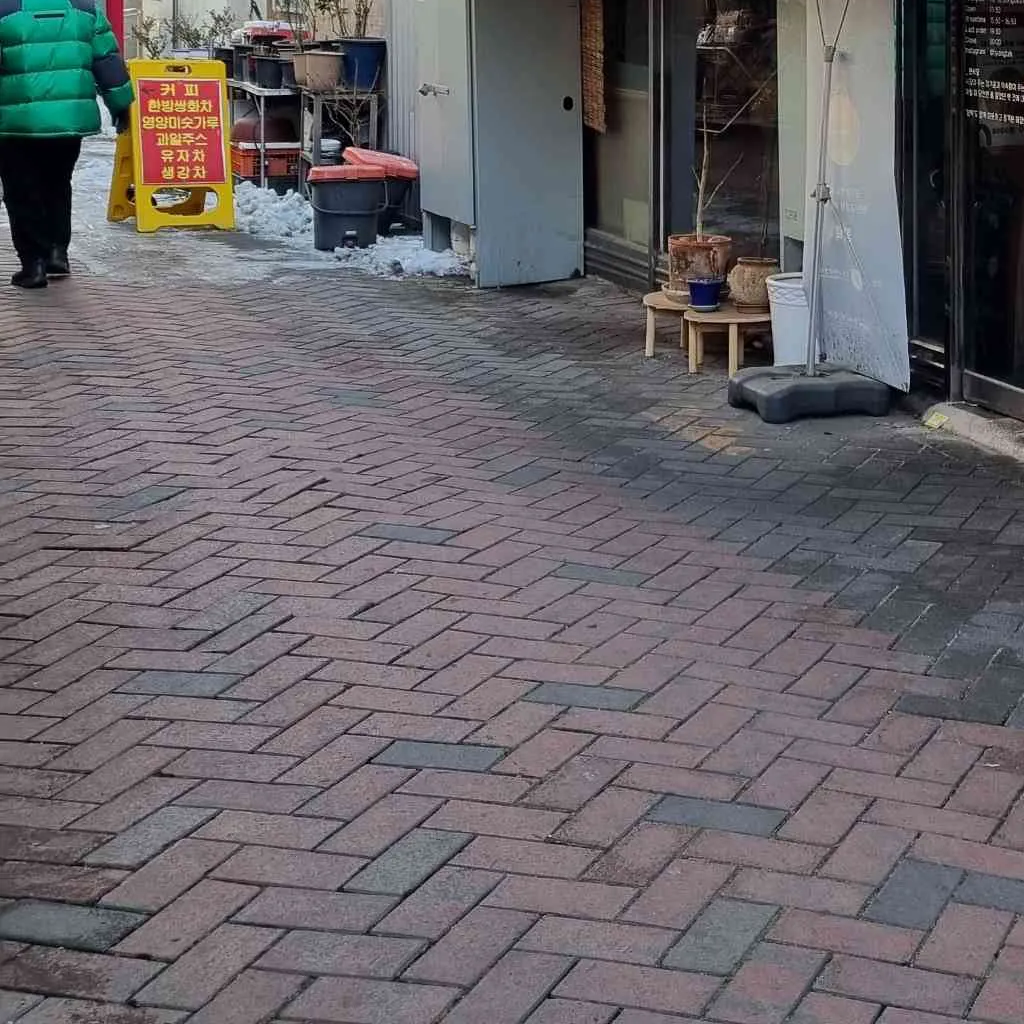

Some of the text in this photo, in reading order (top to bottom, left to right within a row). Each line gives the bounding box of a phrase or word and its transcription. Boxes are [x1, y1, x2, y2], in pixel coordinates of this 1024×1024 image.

[148, 100, 213, 113] 한방쌍화차
[142, 116, 221, 130] 영양미숫가루
[156, 133, 208, 146] 과일주스
[160, 149, 207, 163] 유자차
[161, 166, 208, 179] 생강차
